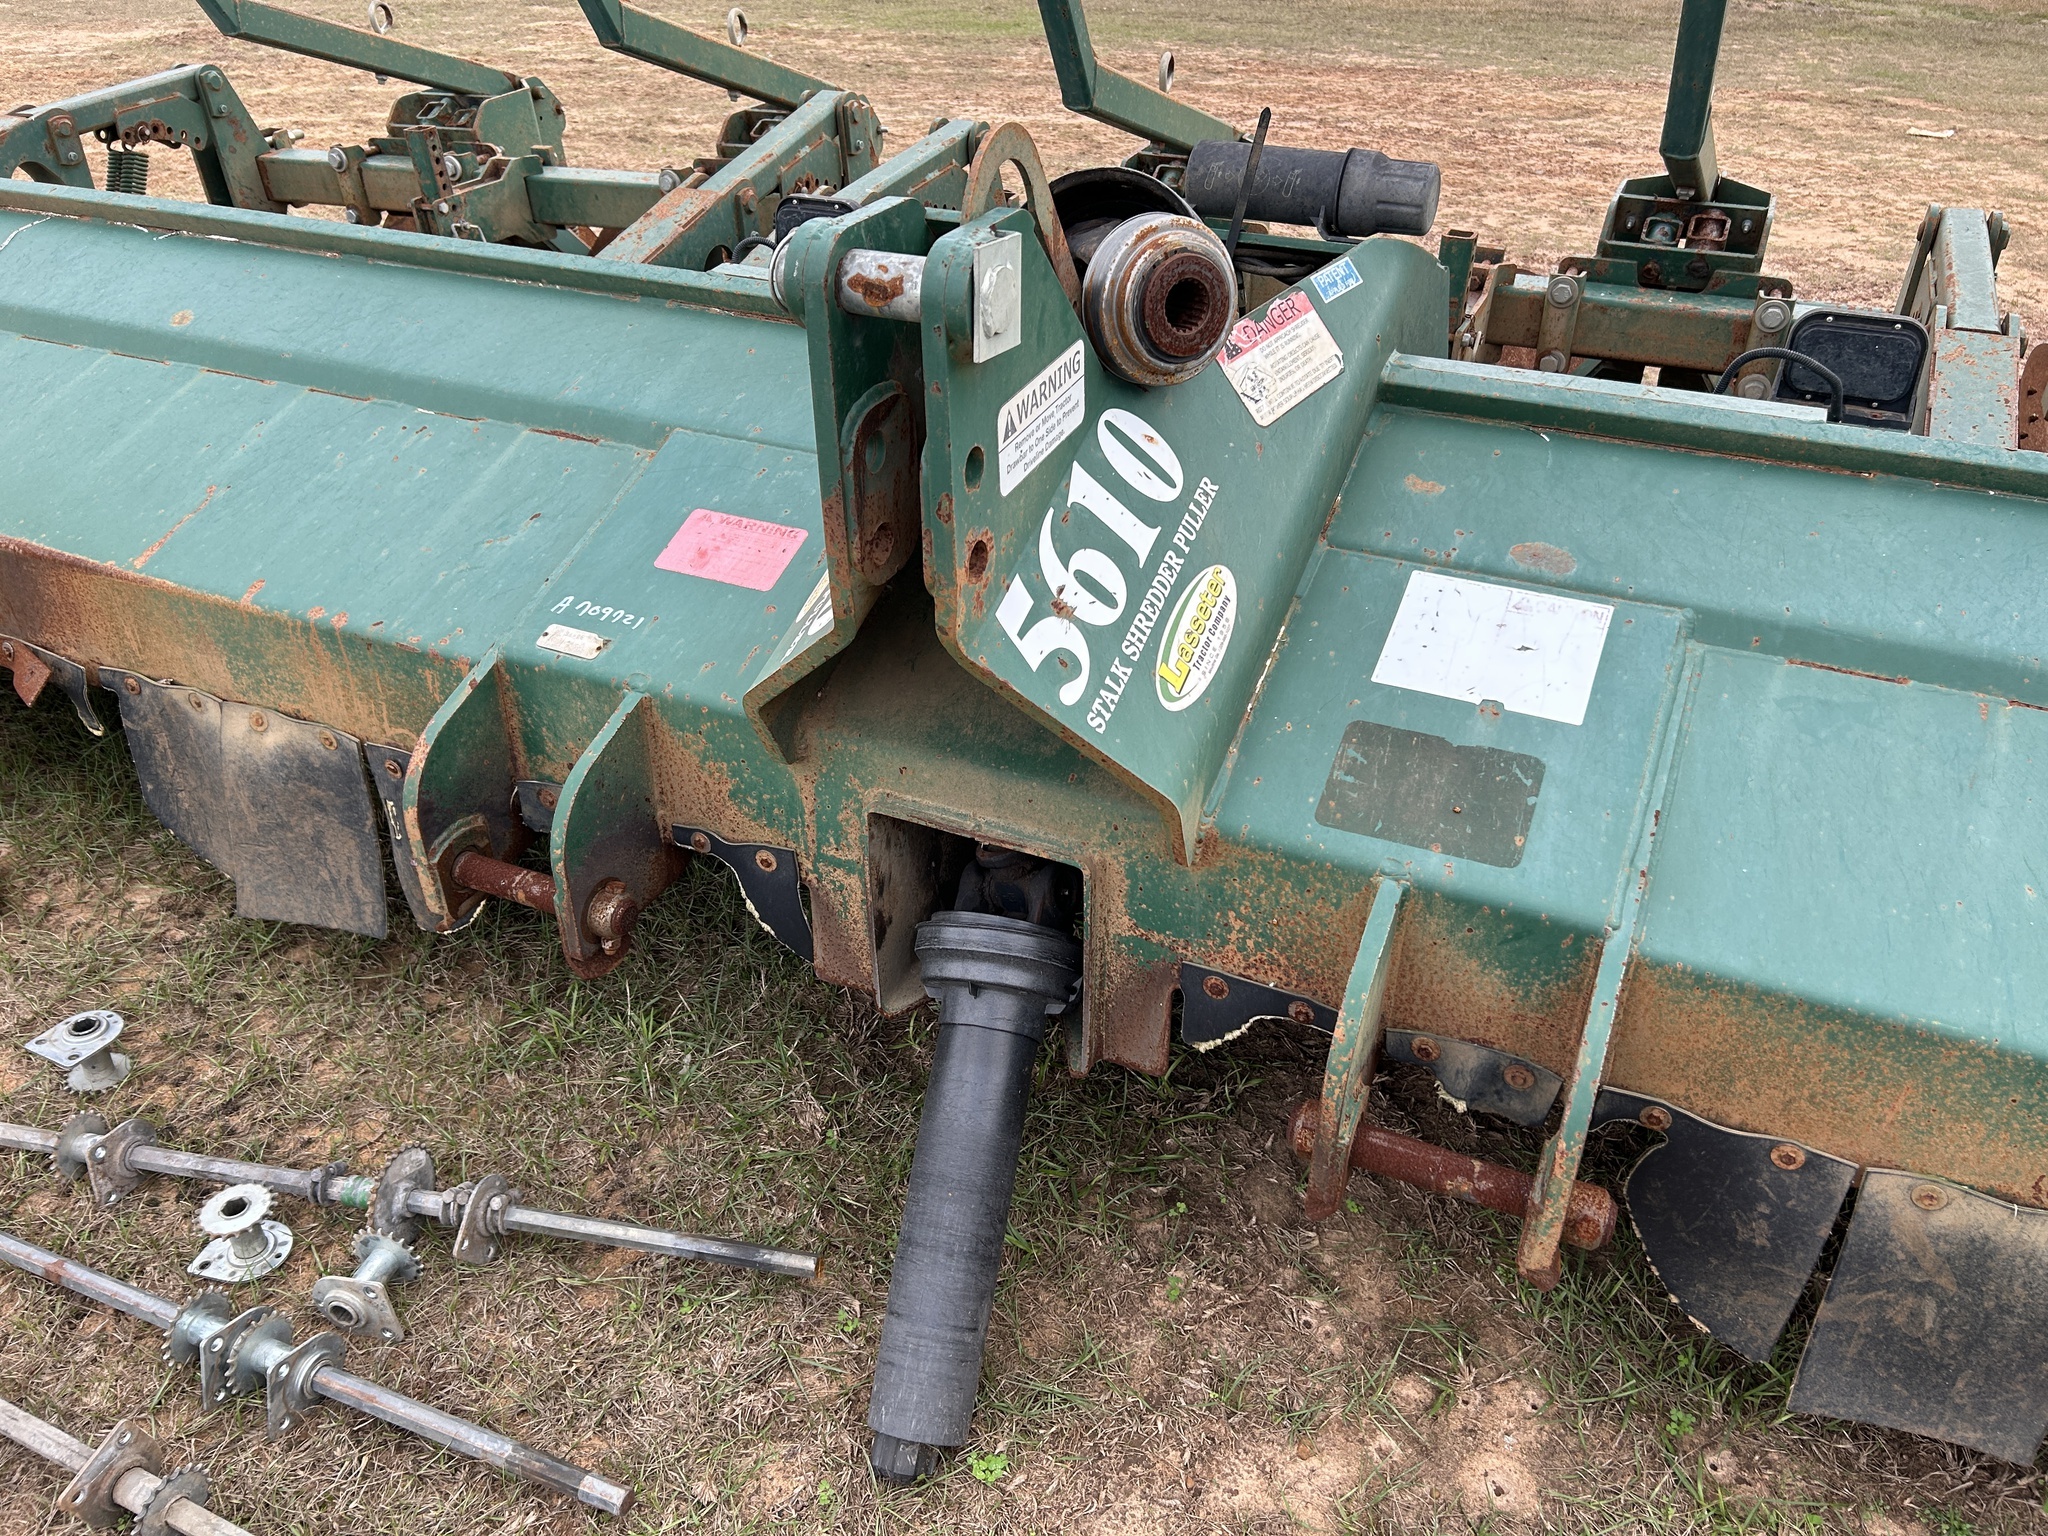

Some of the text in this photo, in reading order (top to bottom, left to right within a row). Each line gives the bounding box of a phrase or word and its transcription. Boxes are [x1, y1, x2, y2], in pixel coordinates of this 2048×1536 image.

[1318, 262, 1349, 287] PATENT
[1242, 297, 1302, 343] DANGER
[1016, 349, 1081, 425] WARNING
[1006, 397, 1079, 475] Drawbar to One Side to Prevent
[1014, 426, 1034, 452] Remove
[1035, 421, 1041, 433] or
[1055, 391, 1071, 414] Tractor
[1023, 445, 1044, 472] Driveline
[719, 515, 799, 540] WARNING
[995, 408, 1184, 706] 5610
[550, 596, 574, 614] A
[1086, 476, 1219, 734] STALK SHREDDER PULLER
[1158, 566, 1226, 694] Lasseter
[1192, 636, 1212, 671] Tractor
[1208, 595, 1231, 636] Company
[1201, 646, 1217, 675] SINCE
